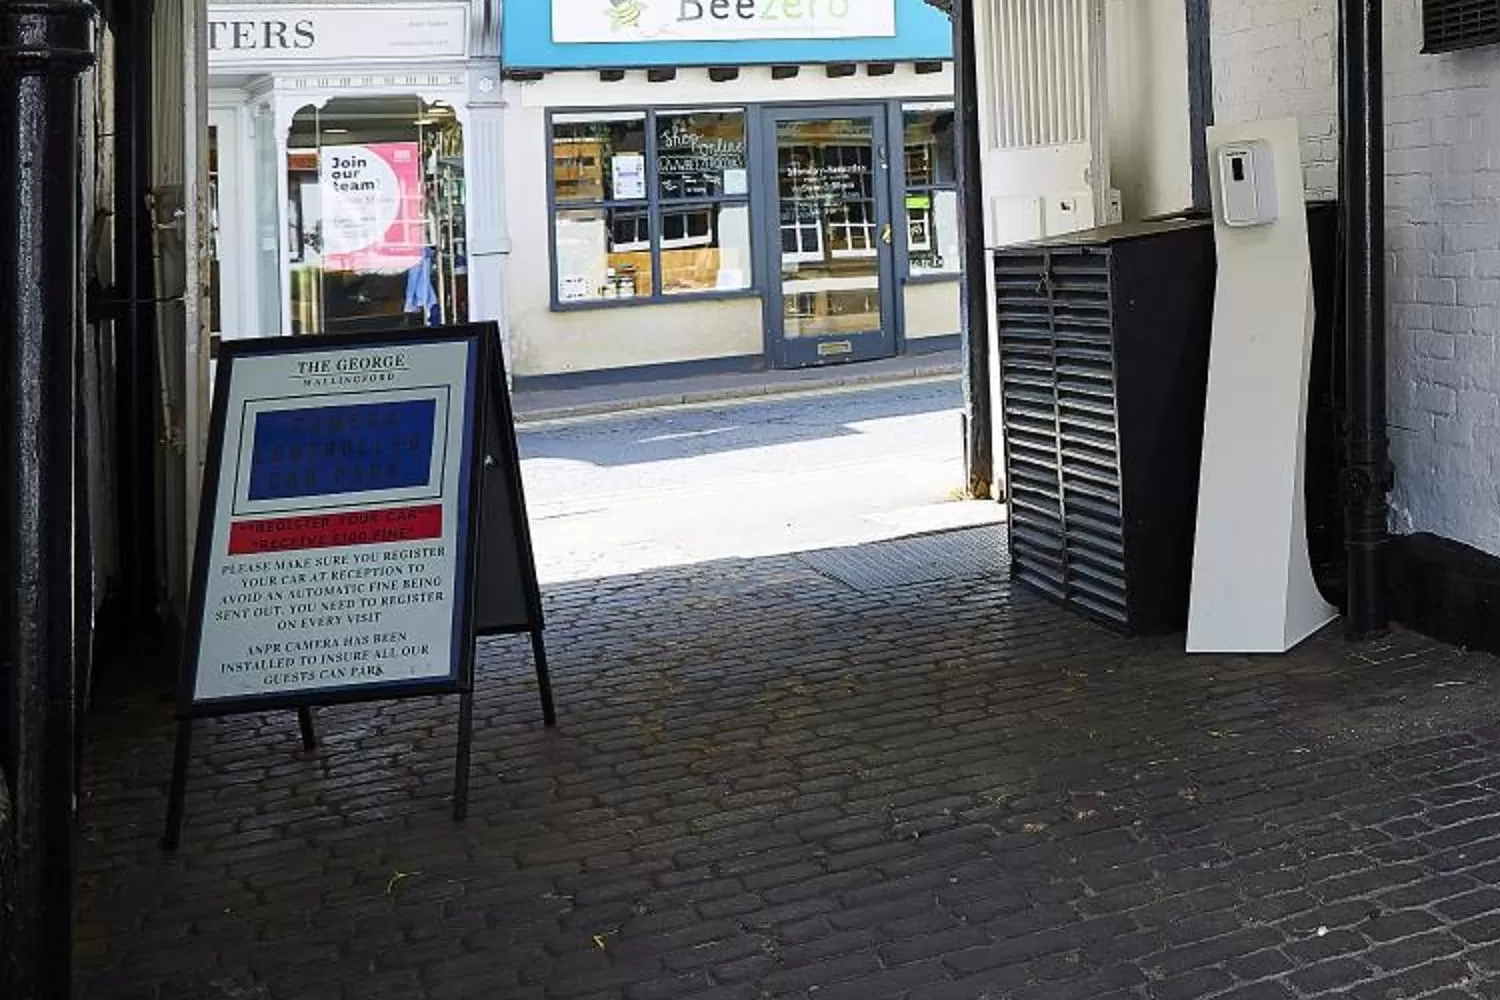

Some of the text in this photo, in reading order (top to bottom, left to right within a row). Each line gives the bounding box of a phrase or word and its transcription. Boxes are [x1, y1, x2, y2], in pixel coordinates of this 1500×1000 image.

[208, 20, 315, 50] TERS
[332, 156, 367, 168] Join
[332, 170, 361, 179] our
[297, 354, 406, 374] THE GEORGE
[302, 373, 396, 388] WALLINGFORD
[221, 547, 445, 576] PLEASE MAKE SURE YOU REGISTER
[241, 563, 425, 589] YOUR CAR AT RECEPTION TO
[220, 576, 441, 605] AVOID AN AUTOMATIC FINE BEING
[214, 607, 250, 621] SENT
[289, 602, 315, 615] YOU
[319, 600, 356, 612] NEED
[359, 597, 377, 609] TO
[381, 592, 444, 607] REGISTER
[277, 611, 382, 631] ON EVERY VISIT
[247, 631, 408, 656] ANPR CAMERA HAS BEEN
[220, 644, 430, 673] INSTALLED TO INSURE ALL OUR
[263, 663, 385, 685] GUESTS CAN PARK
